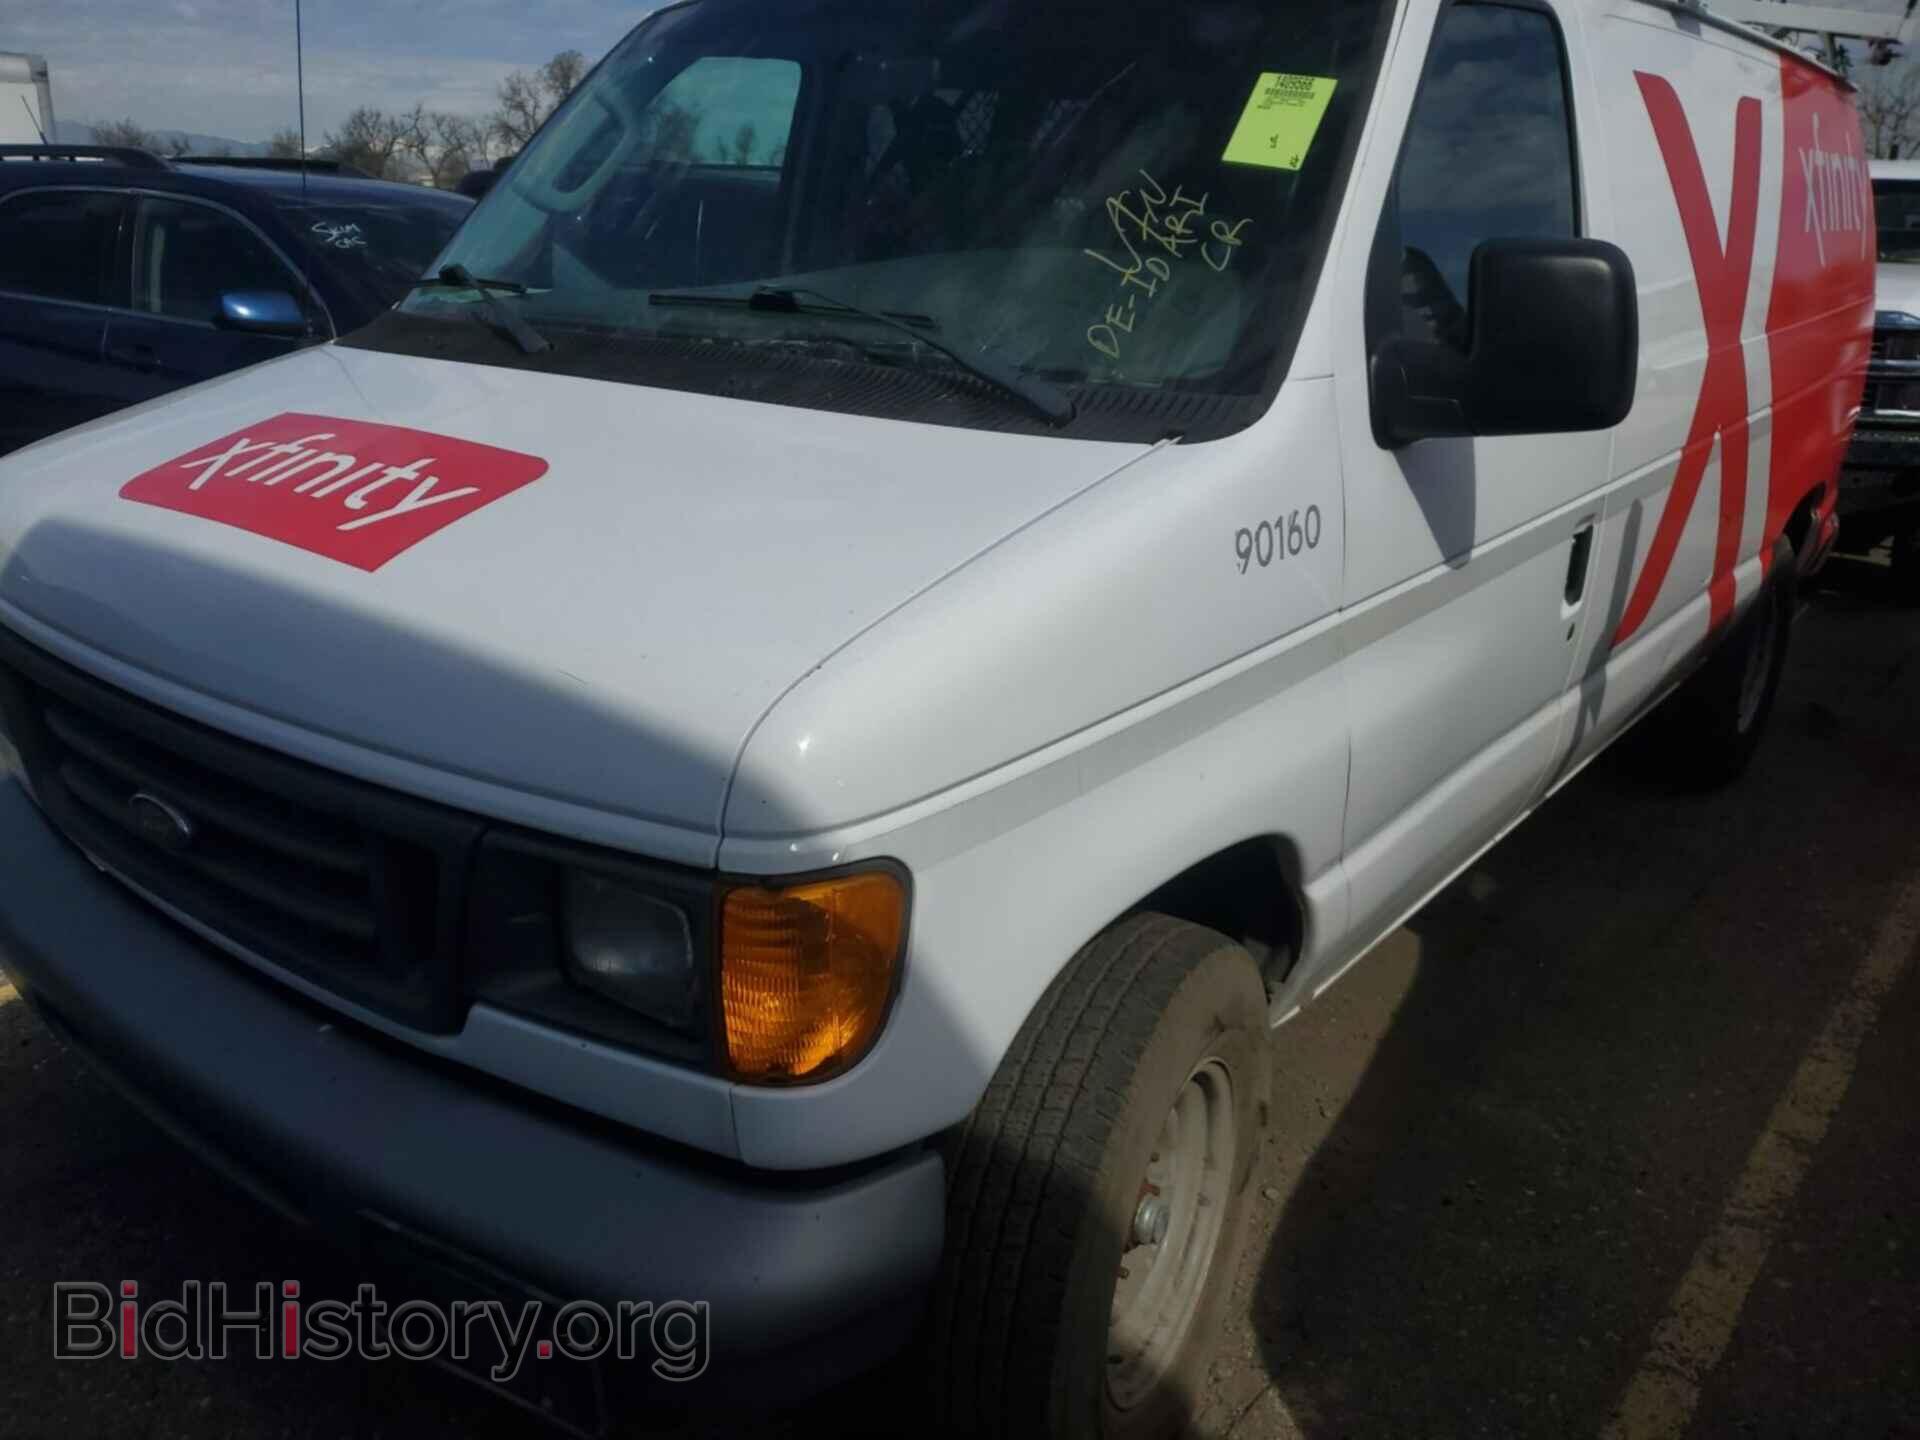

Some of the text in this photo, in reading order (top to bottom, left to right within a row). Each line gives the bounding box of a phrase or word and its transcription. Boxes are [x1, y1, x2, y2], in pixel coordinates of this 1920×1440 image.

[1799, 112, 1867, 268] xfinity
[1201, 217, 1254, 272] CR
[180, 432, 481, 531] xfinity
[1235, 503, 1322, 575] 90160
